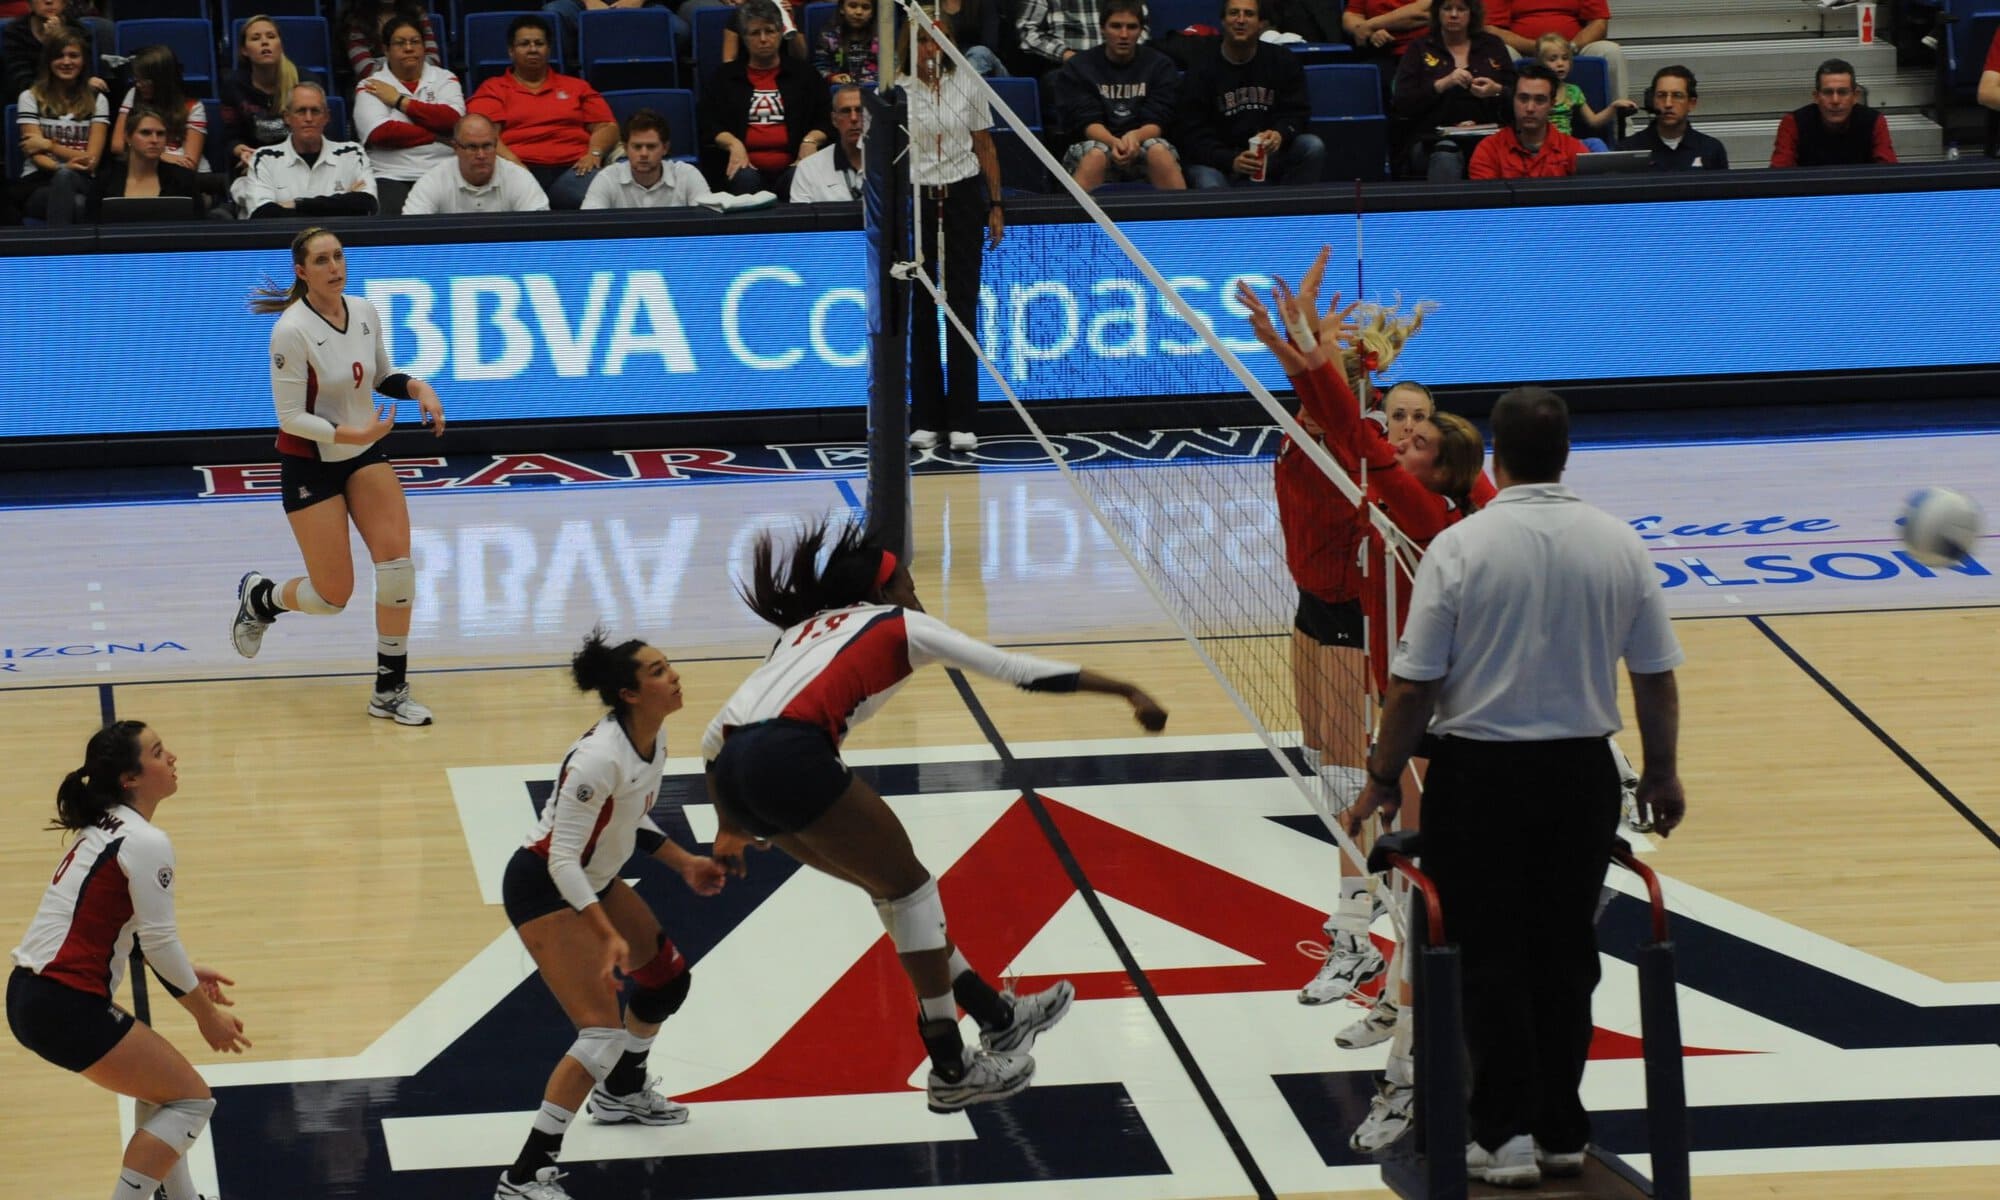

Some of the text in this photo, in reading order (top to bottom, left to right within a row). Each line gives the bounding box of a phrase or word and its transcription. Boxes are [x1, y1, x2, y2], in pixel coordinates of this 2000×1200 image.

[364, 269, 698, 383] BBVA
[352, 361, 364, 389] 9
[1628, 514, 1840, 540] Lute
